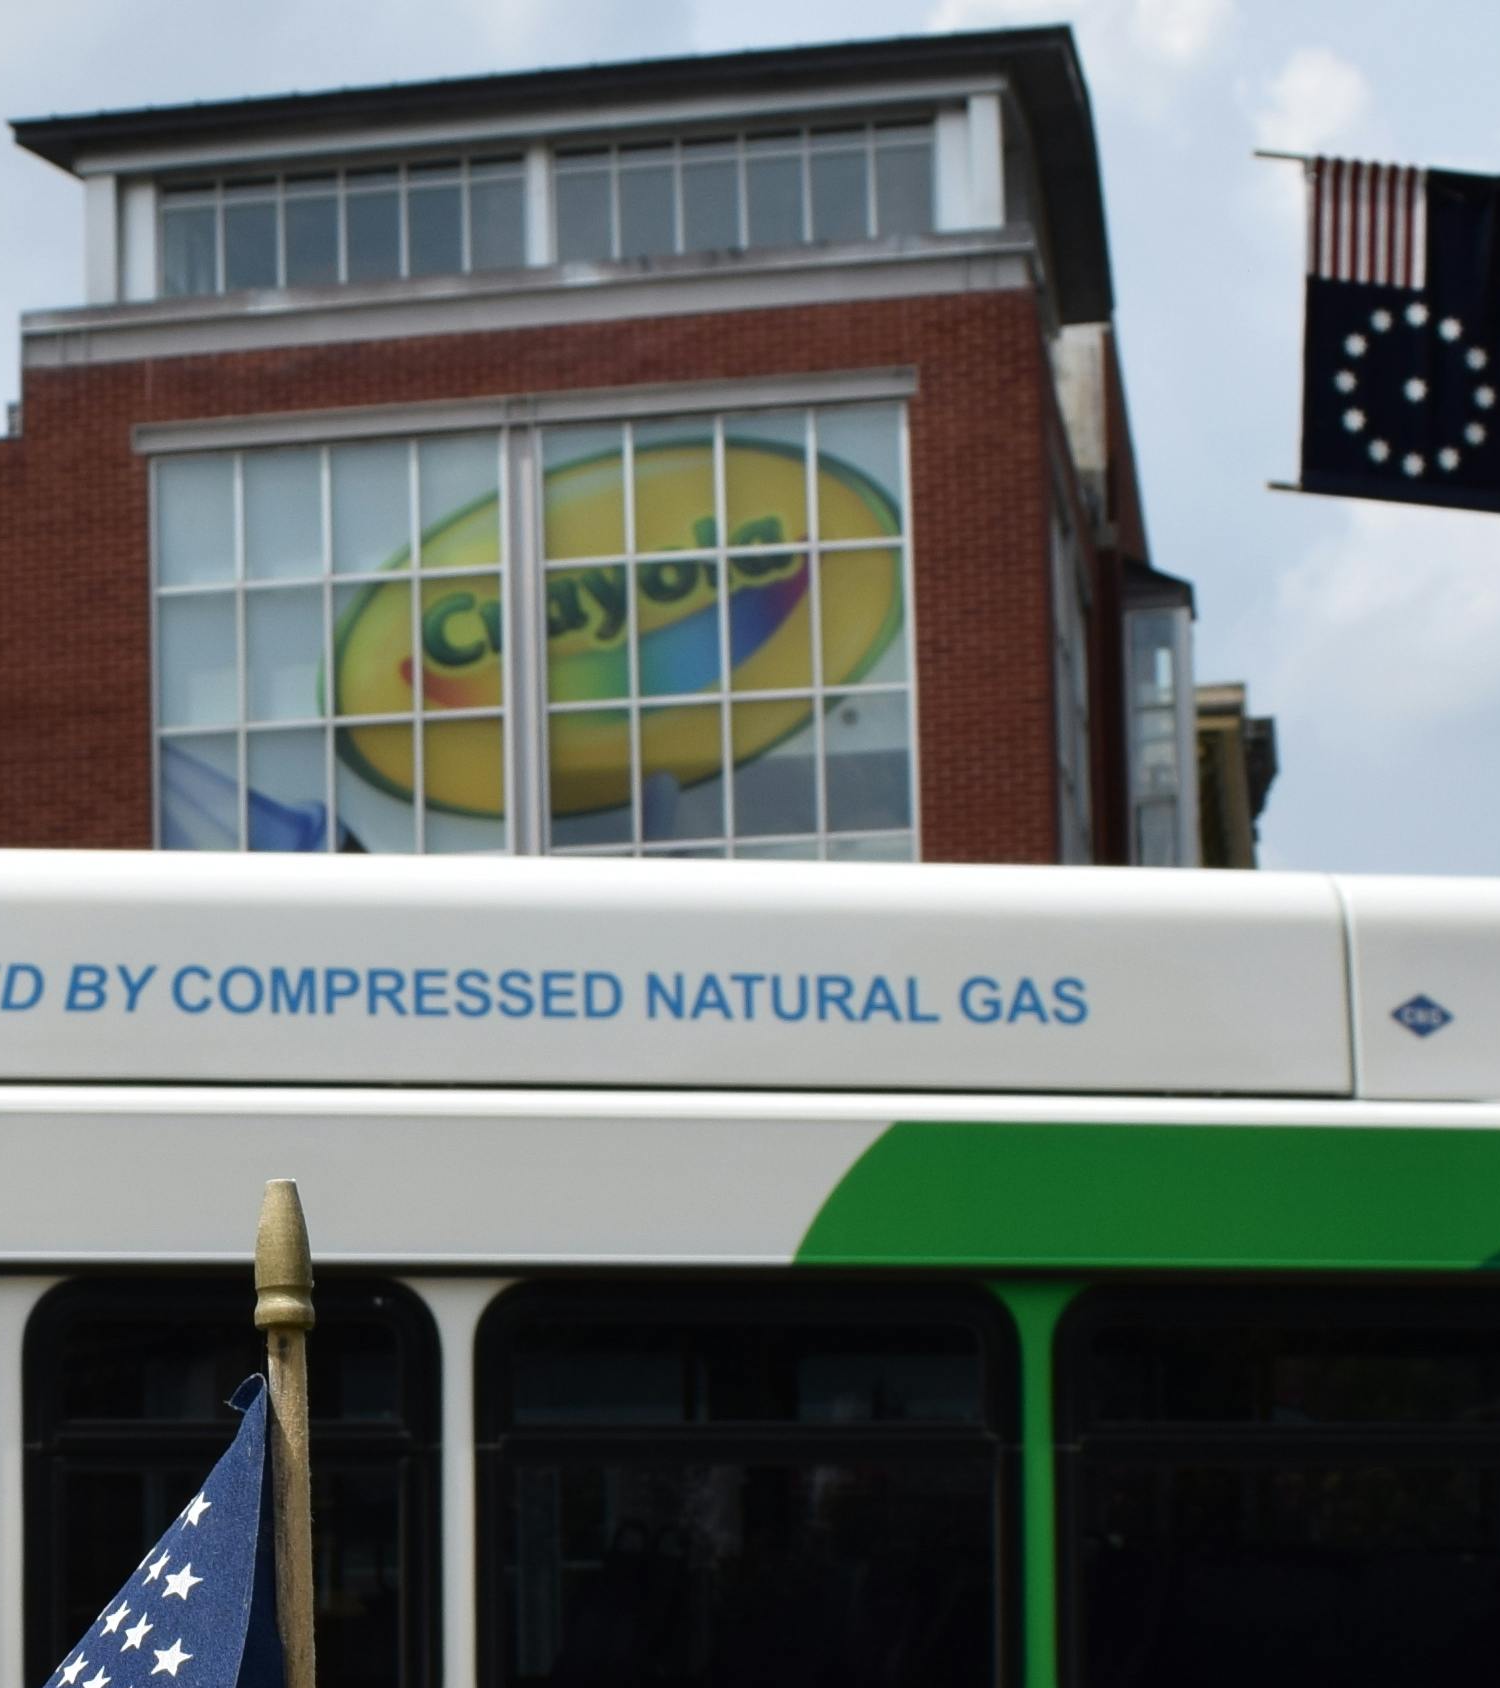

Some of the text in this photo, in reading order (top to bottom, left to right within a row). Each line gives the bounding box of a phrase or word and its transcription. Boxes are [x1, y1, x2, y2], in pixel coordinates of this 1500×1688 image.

[63, 961, 158, 1012] BY
[170, 963, 625, 1020] COMPRESSED
[645, 970, 940, 1024] NATURAL
[959, 975, 1091, 1026] GAS
